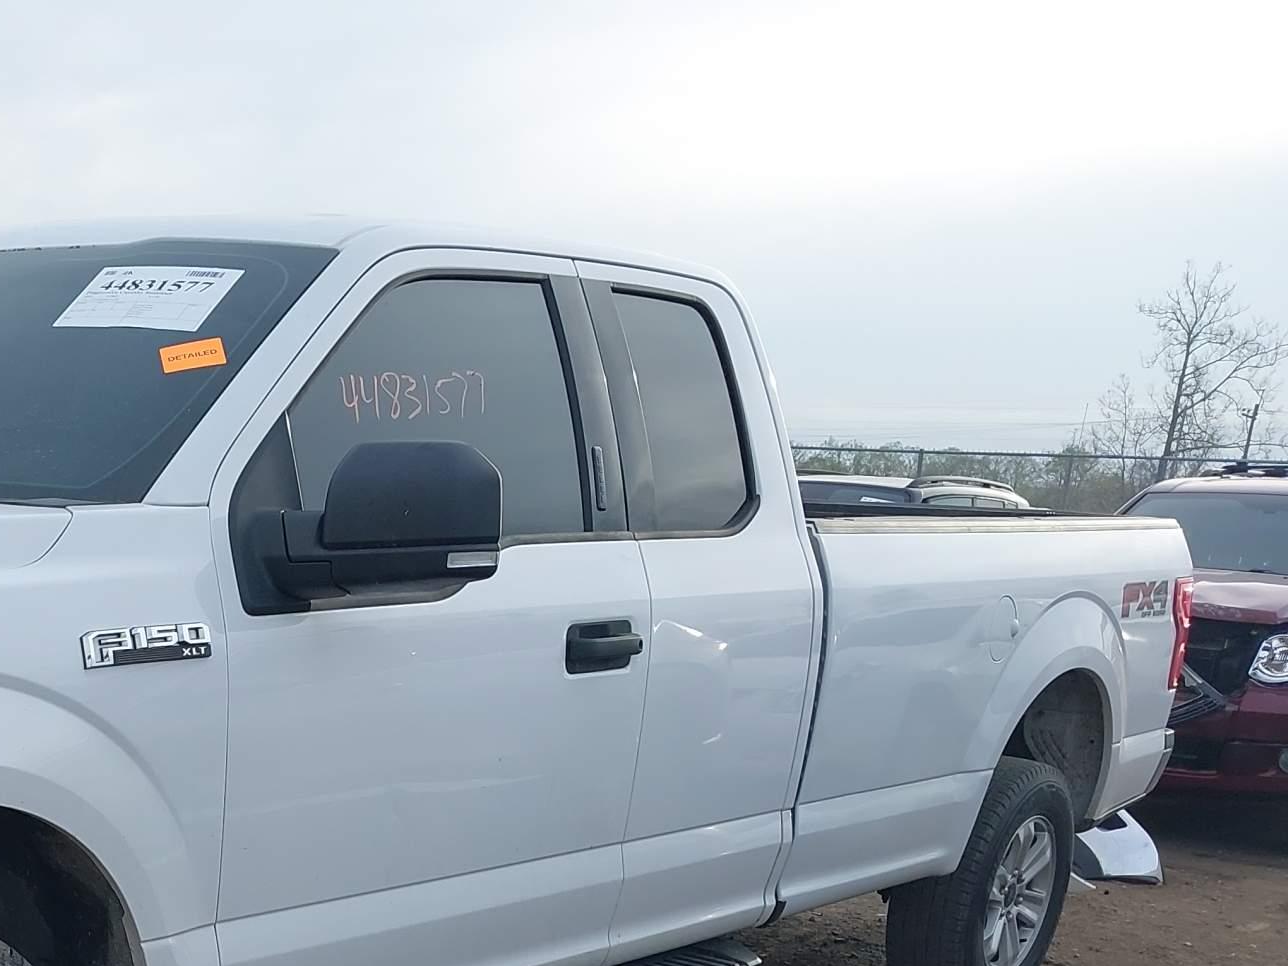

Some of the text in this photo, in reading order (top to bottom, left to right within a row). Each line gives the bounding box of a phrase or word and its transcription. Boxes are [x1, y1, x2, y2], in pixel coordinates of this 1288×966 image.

[100, 278, 216, 294] 44831577
[167, 348, 218, 362] DETAILED
[339, 370, 485, 424] 44831577
[1121, 580, 1169, 618] FX4
[182, 647, 208, 657] XLT
